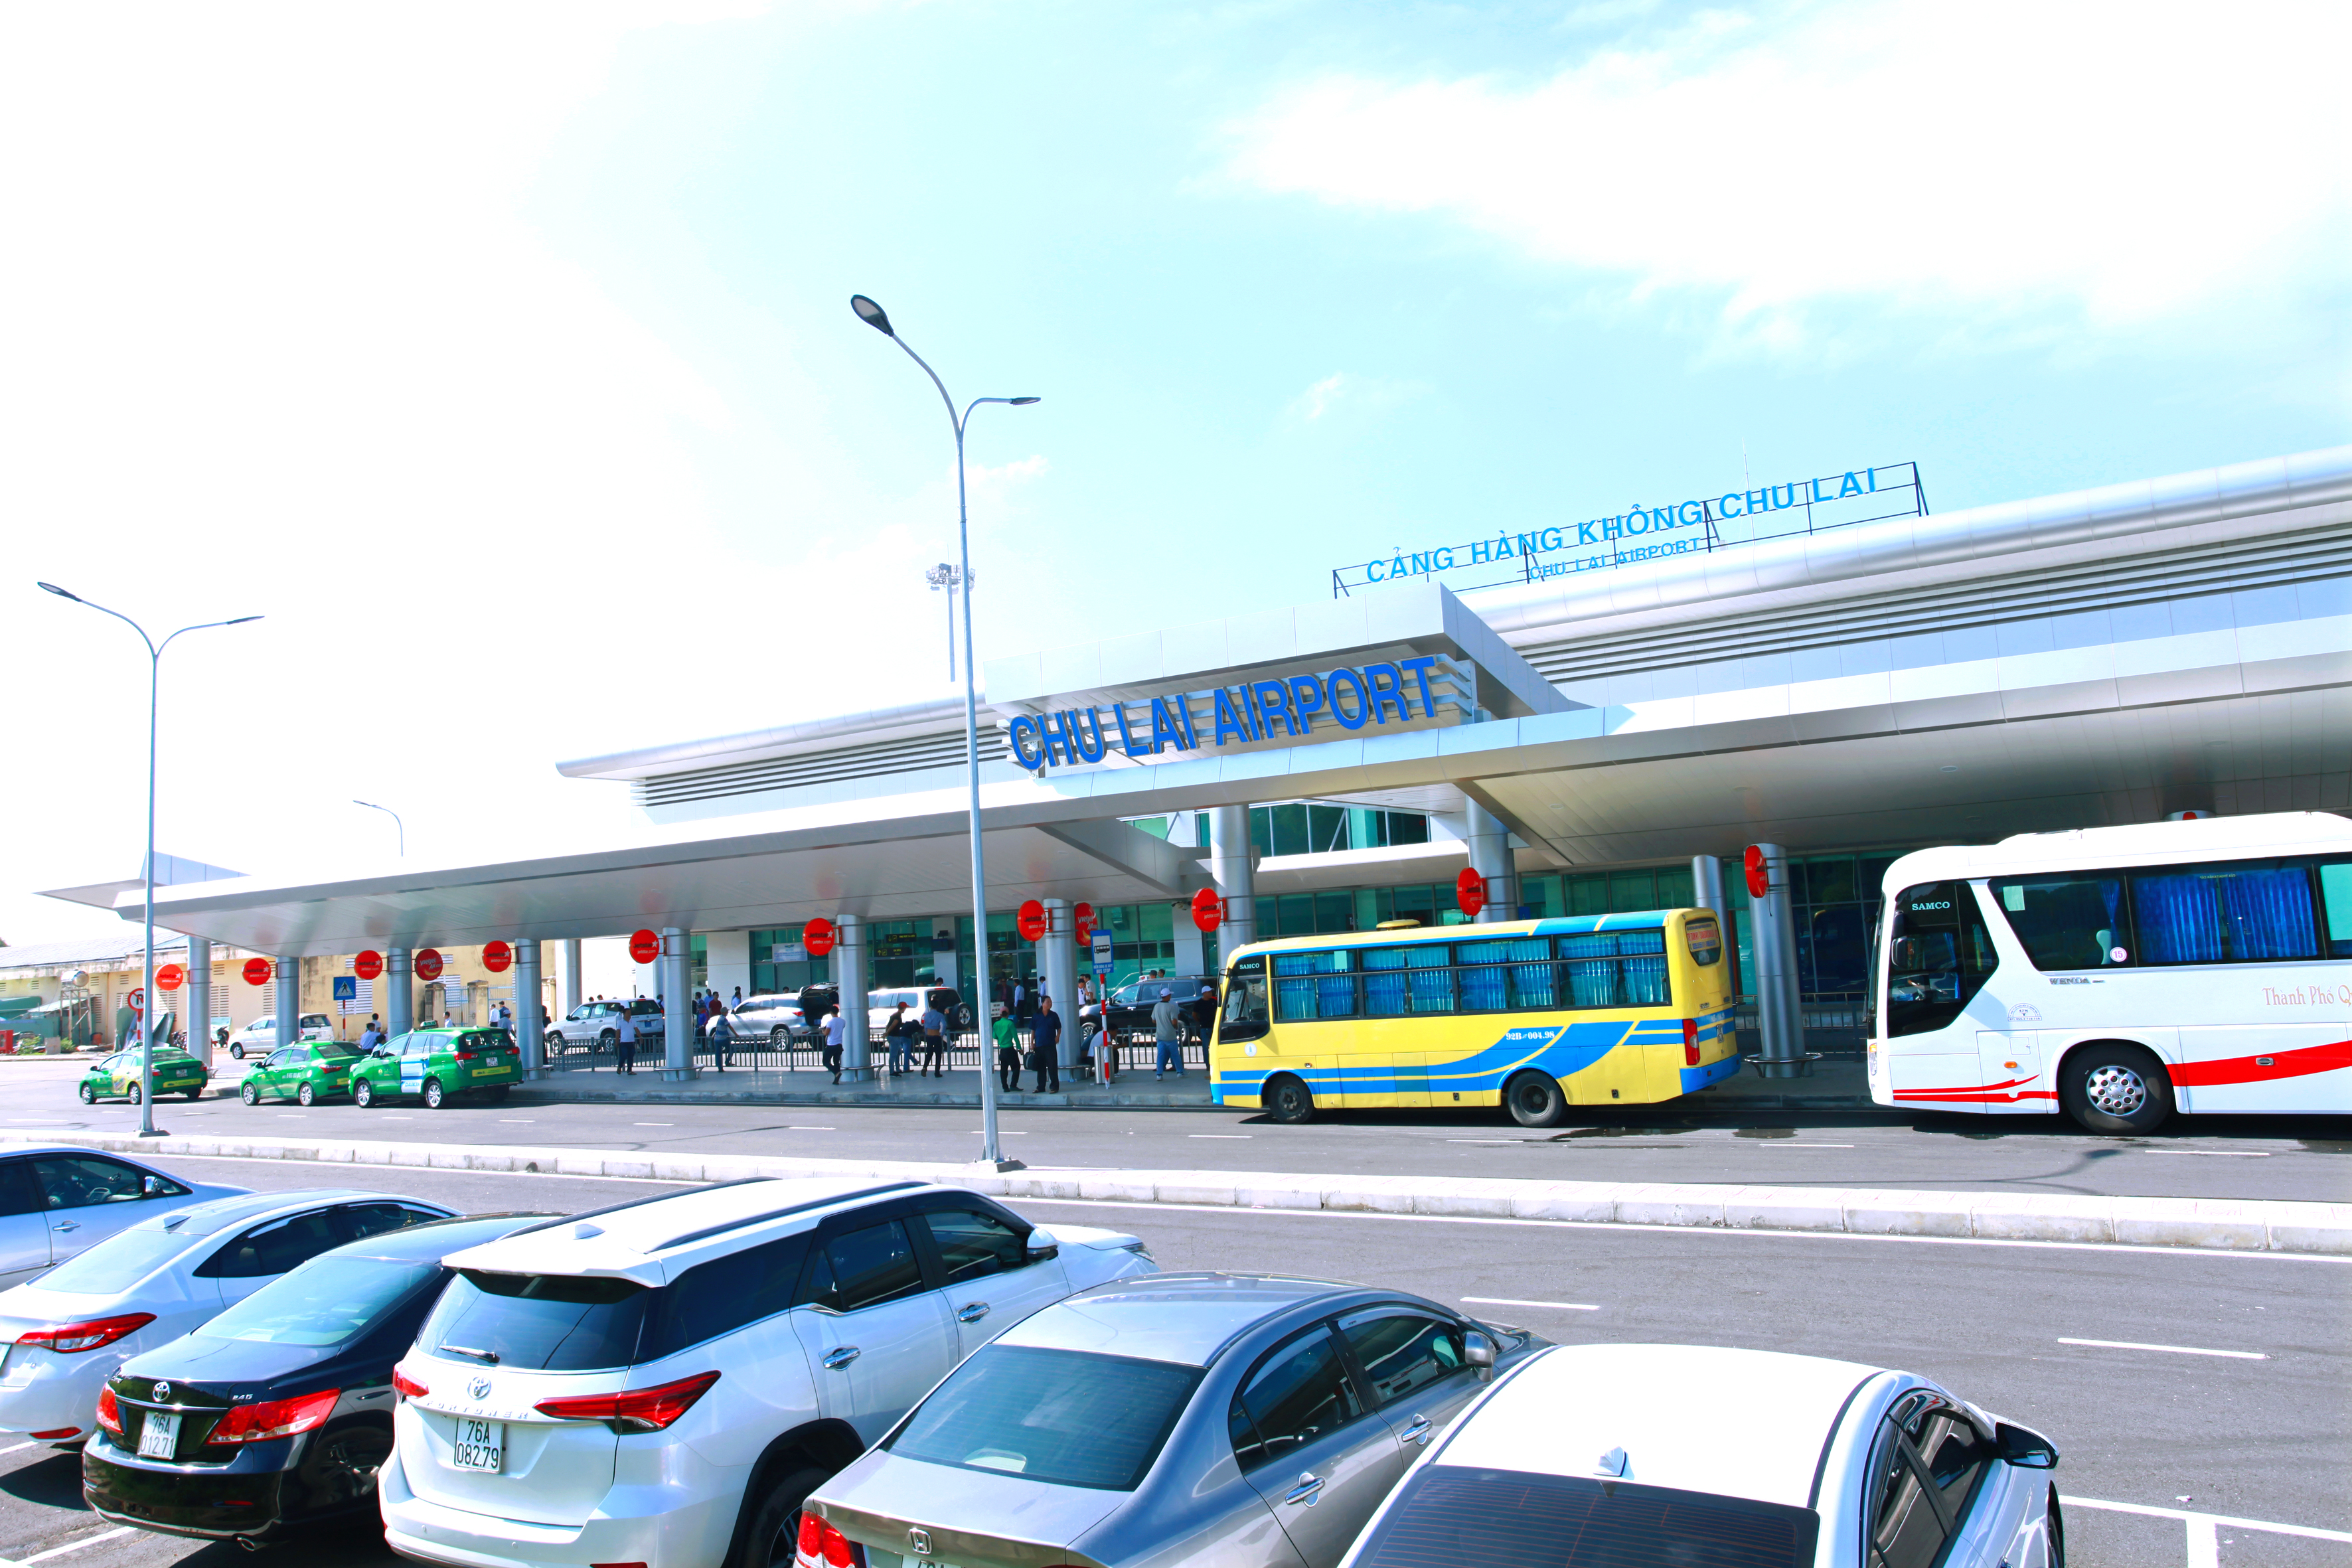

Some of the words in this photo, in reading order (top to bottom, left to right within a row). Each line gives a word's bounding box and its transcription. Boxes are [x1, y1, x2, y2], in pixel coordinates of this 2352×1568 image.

[1366, 547, 1454, 582] CẢNG
[1471, 526, 1563, 564] HÀNG
[1577, 501, 1703, 545] KHÔNG
[1719, 482, 1794, 518] CHU
[1812, 467, 1876, 503] LAI
[1529, 562, 1566, 580] CHU
[1575, 554, 1606, 572] LAI
[1617, 537, 1701, 564] AIRPORT
[1010, 705, 1108, 771] CHU
[1113, 692, 1200, 757] LAI
[1214, 655, 1440, 745] AIRPORT
[1912, 902, 1950, 911] SAMCO
[2114, 950, 2124, 959] 15
[2261, 986, 2306, 1005] Thành
[2308, 985, 2334, 1006] Phố
[2338, 984, 2352, 1008] Q
[426, 1401, 530, 1419] FORTUNER
[153, 1413, 171, 1435] 76A
[467, 1419, 490, 1444] 76A
[140, 1435, 175, 1456] 012.71
[457, 1443, 499, 1469] 082.79
